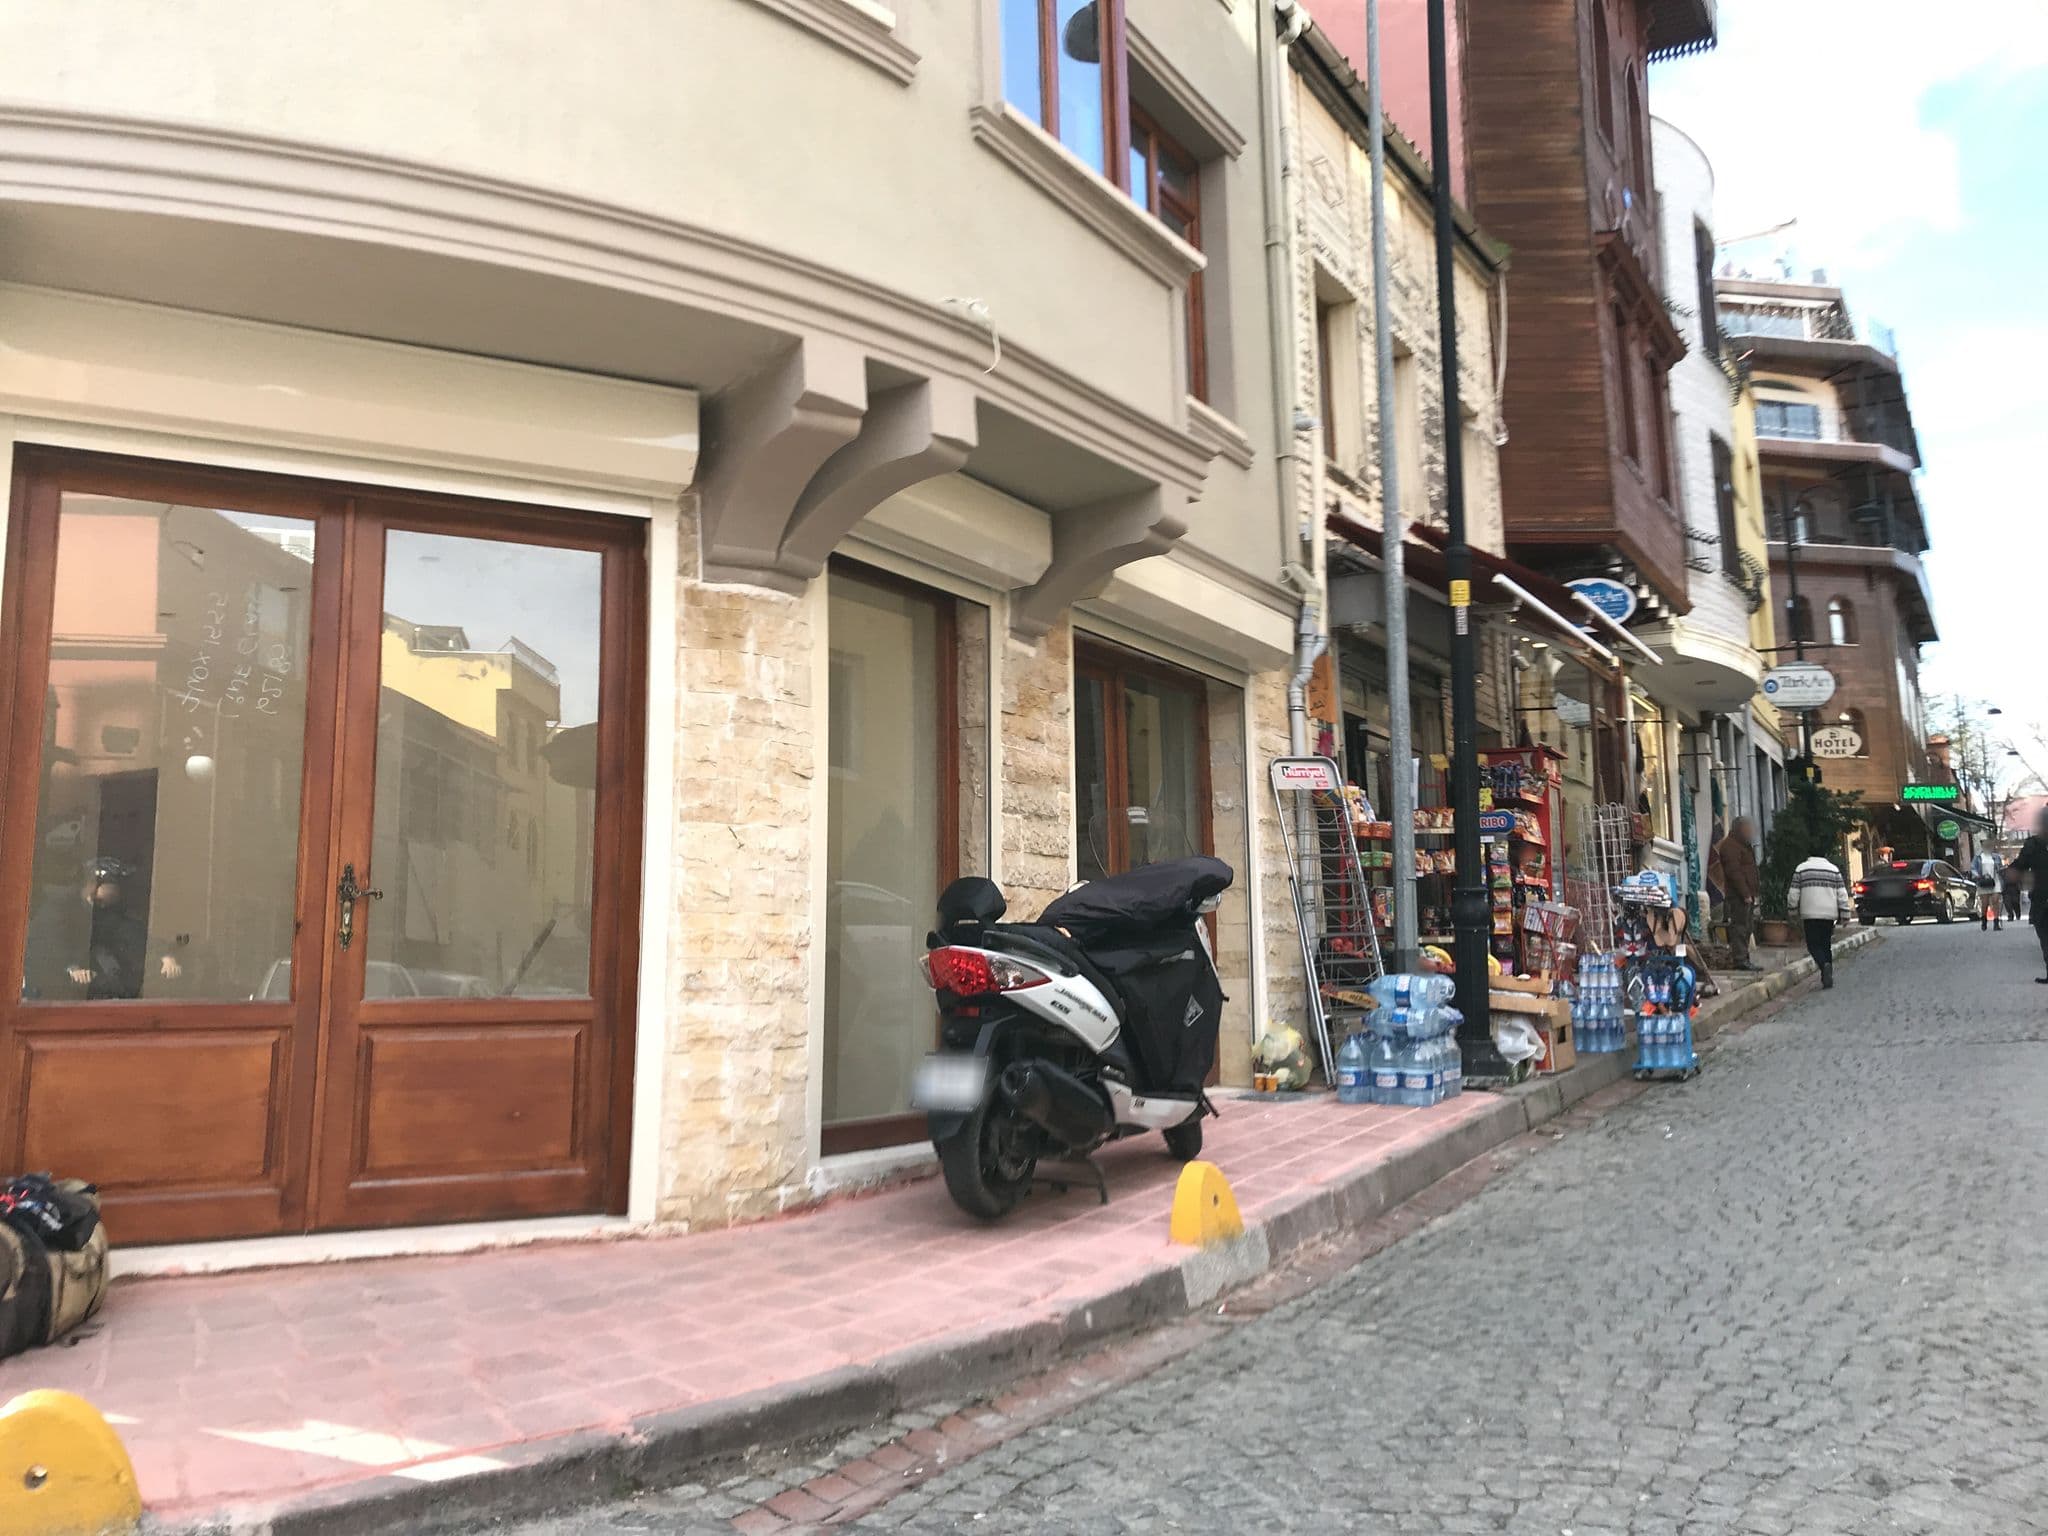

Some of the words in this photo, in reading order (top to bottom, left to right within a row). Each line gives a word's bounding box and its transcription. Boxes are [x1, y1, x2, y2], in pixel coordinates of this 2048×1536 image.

[1815, 737, 1856, 749] HOTEL
[1823, 748, 1847, 756] PARK
[1480, 816, 1508, 829] RIBO
